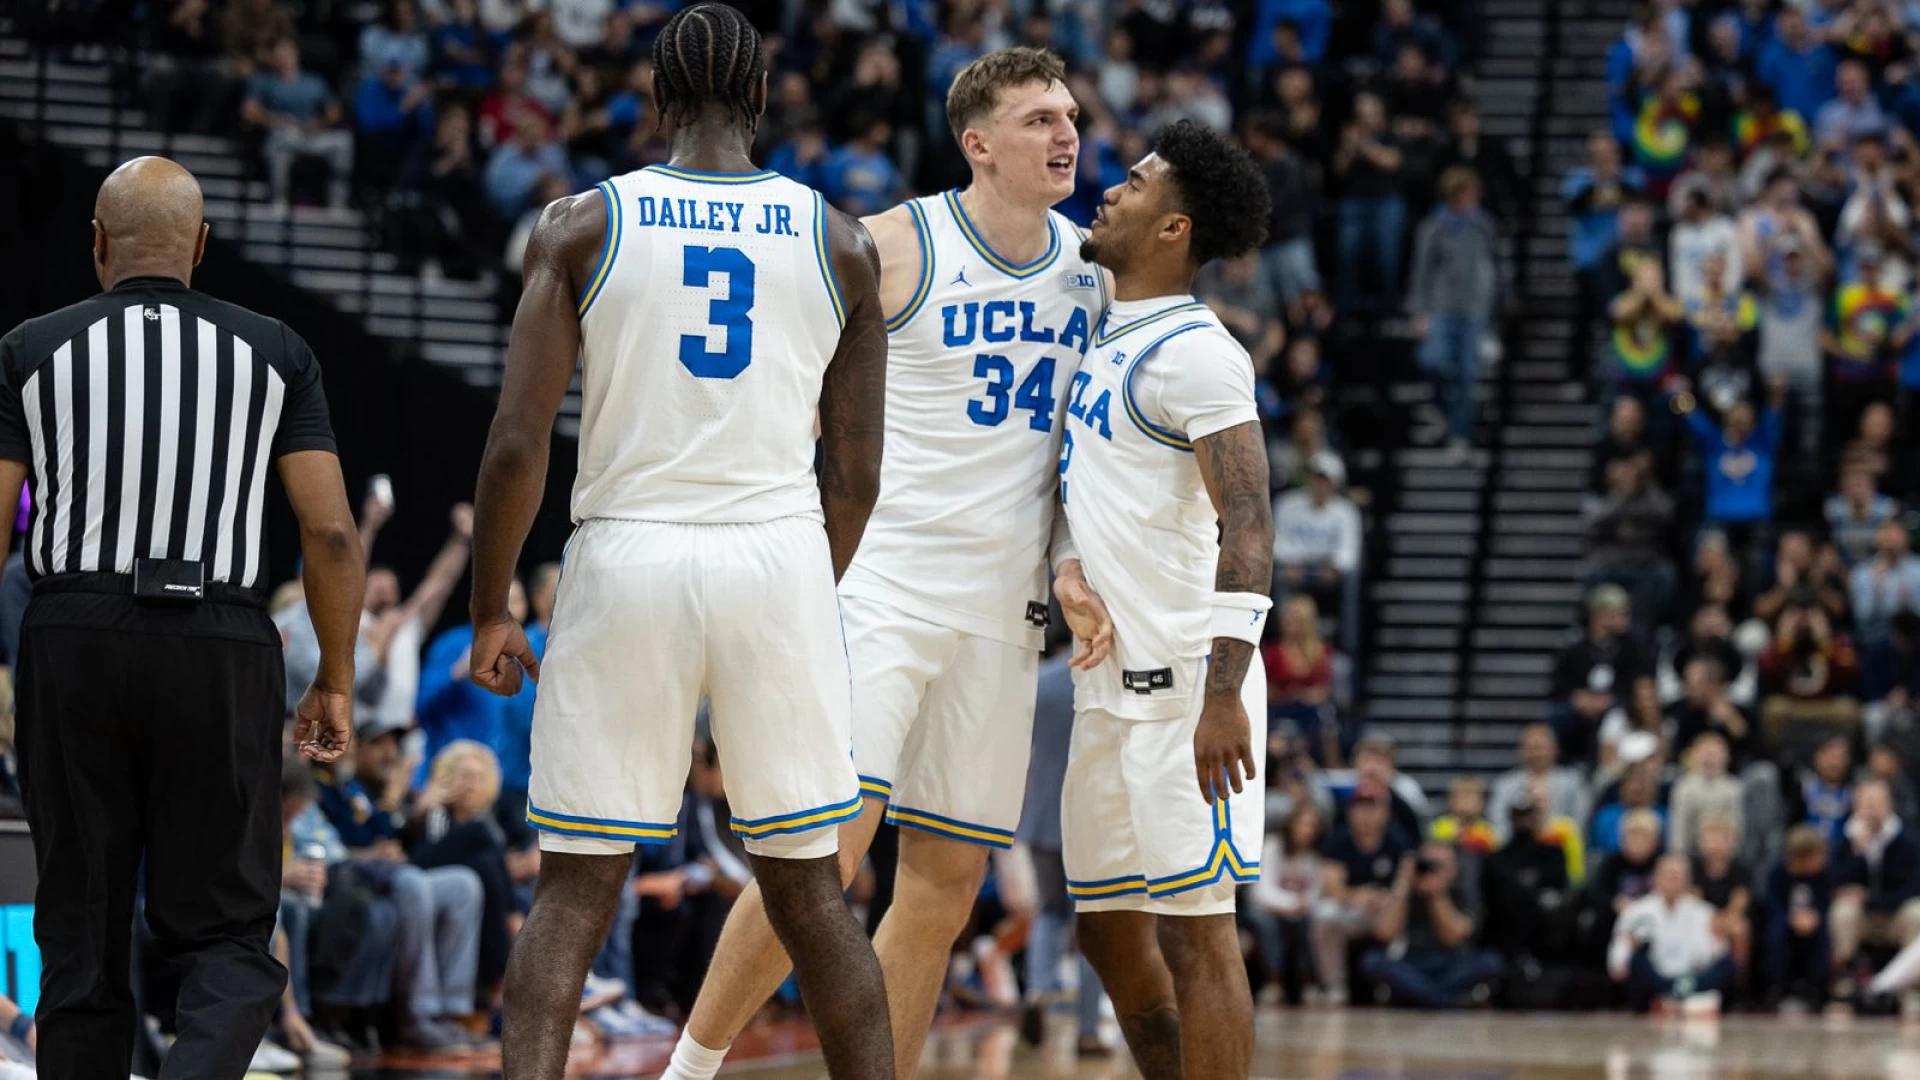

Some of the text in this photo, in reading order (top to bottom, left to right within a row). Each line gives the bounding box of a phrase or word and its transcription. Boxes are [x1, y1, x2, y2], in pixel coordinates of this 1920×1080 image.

[638, 196, 799, 237] DAILEY JR.
[679, 245, 755, 379] 3
[942, 301, 1088, 355] UCLA
[967, 354, 1056, 432] 34
